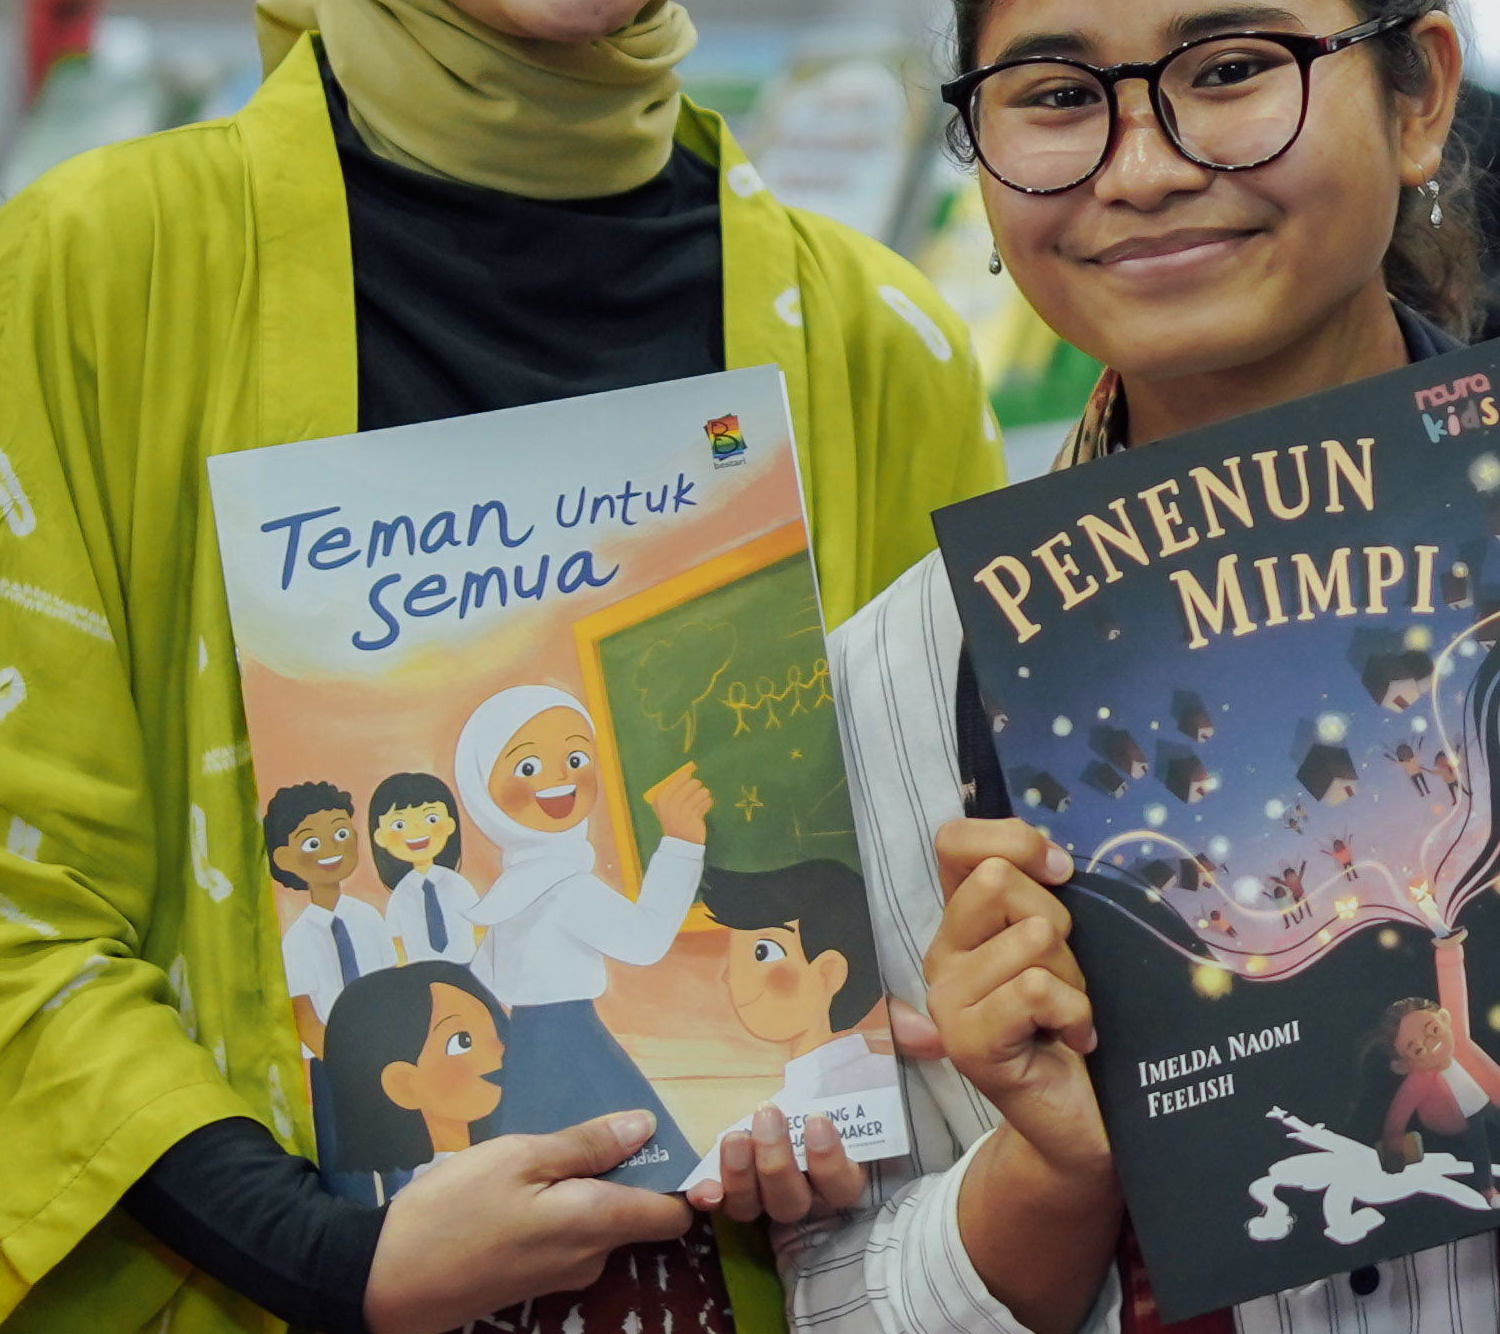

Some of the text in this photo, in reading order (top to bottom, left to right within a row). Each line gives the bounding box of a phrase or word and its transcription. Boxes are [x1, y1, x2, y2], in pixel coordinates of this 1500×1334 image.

[1414, 373, 1492, 411] noura
[1421, 396, 1500, 444] kids
[260, 473, 698, 591] Teman Untuk
[973, 436, 1376, 644] PENENUN
[1169, 544, 1440, 650] MIMPI
[1138, 1019, 1301, 1087] IMELDA NAOMI
[856, 1104, 866, 1118] A
[1147, 1073, 1235, 1118] FEELISH
